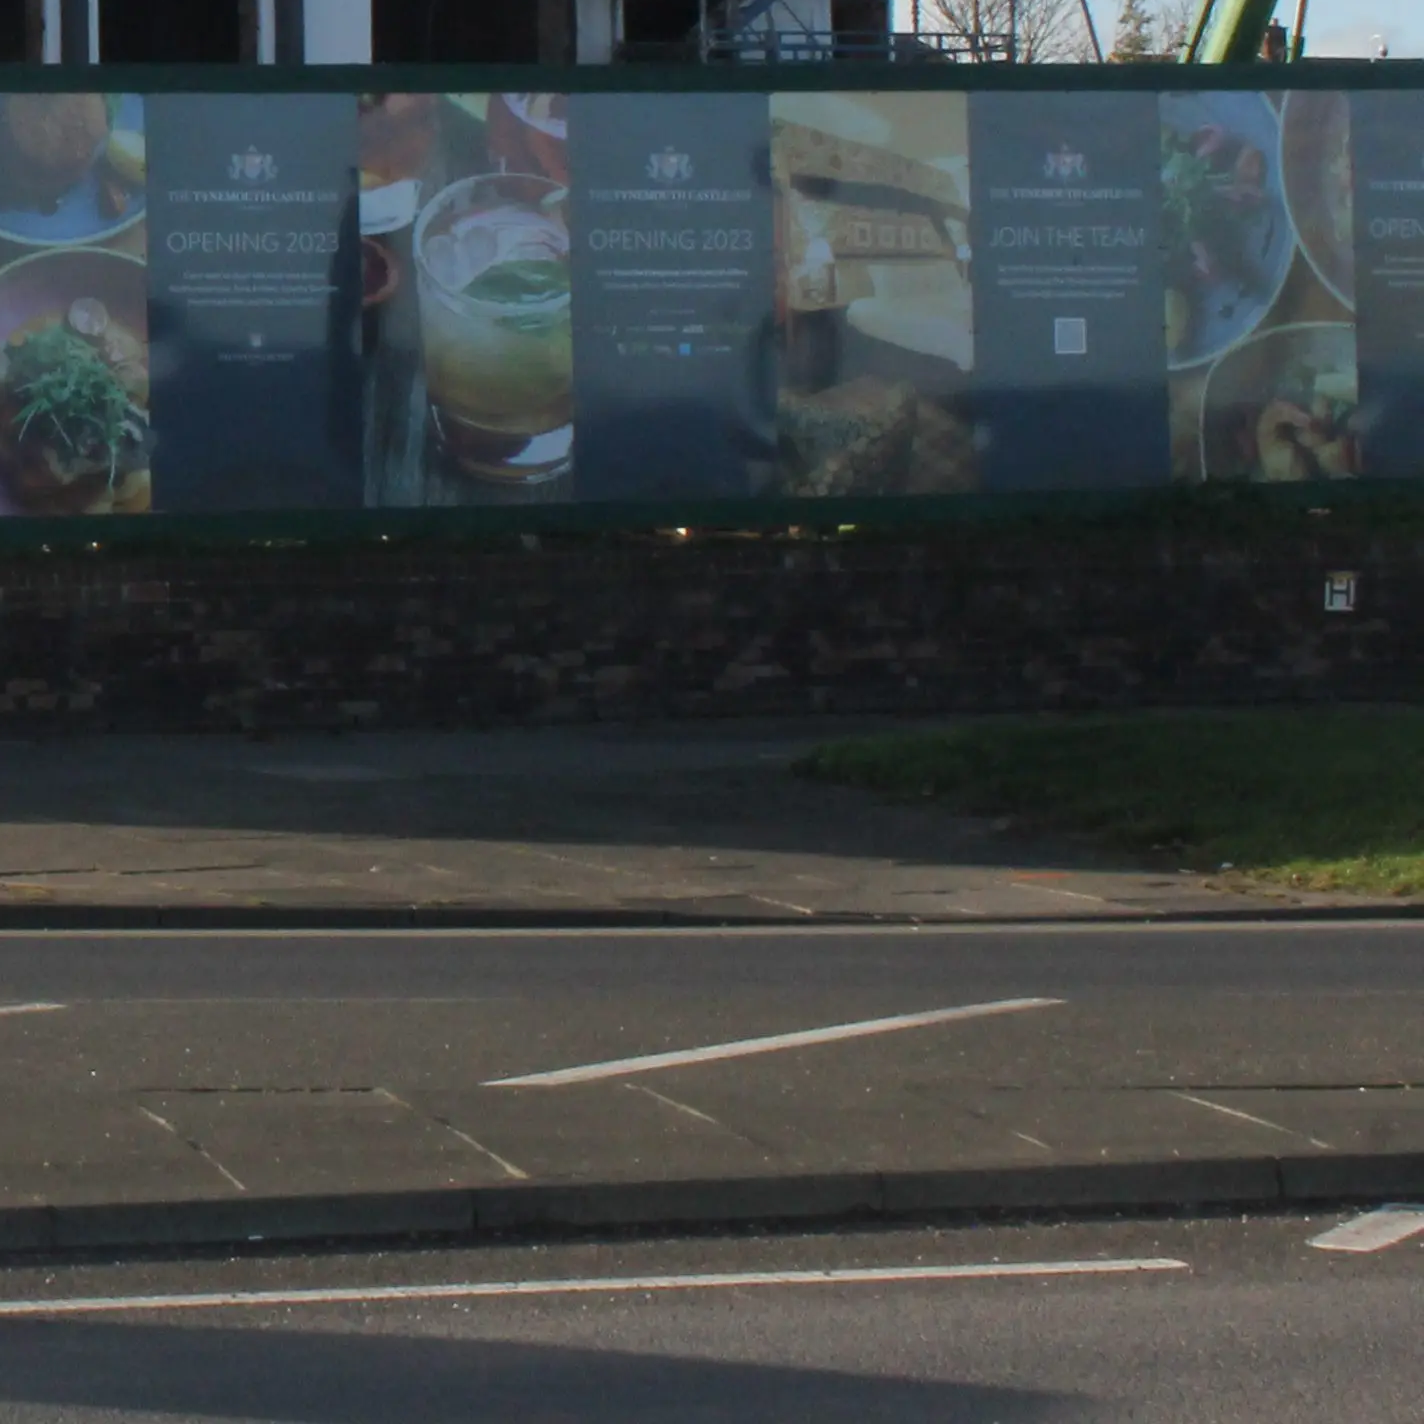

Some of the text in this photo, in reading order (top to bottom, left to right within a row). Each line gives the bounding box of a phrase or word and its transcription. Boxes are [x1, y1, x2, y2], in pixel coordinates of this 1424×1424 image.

[167, 231, 339, 253] OPENING 2023
[588, 228, 754, 251] OPENING 2023
[989, 225, 1145, 248] JOIN THE TEAM
